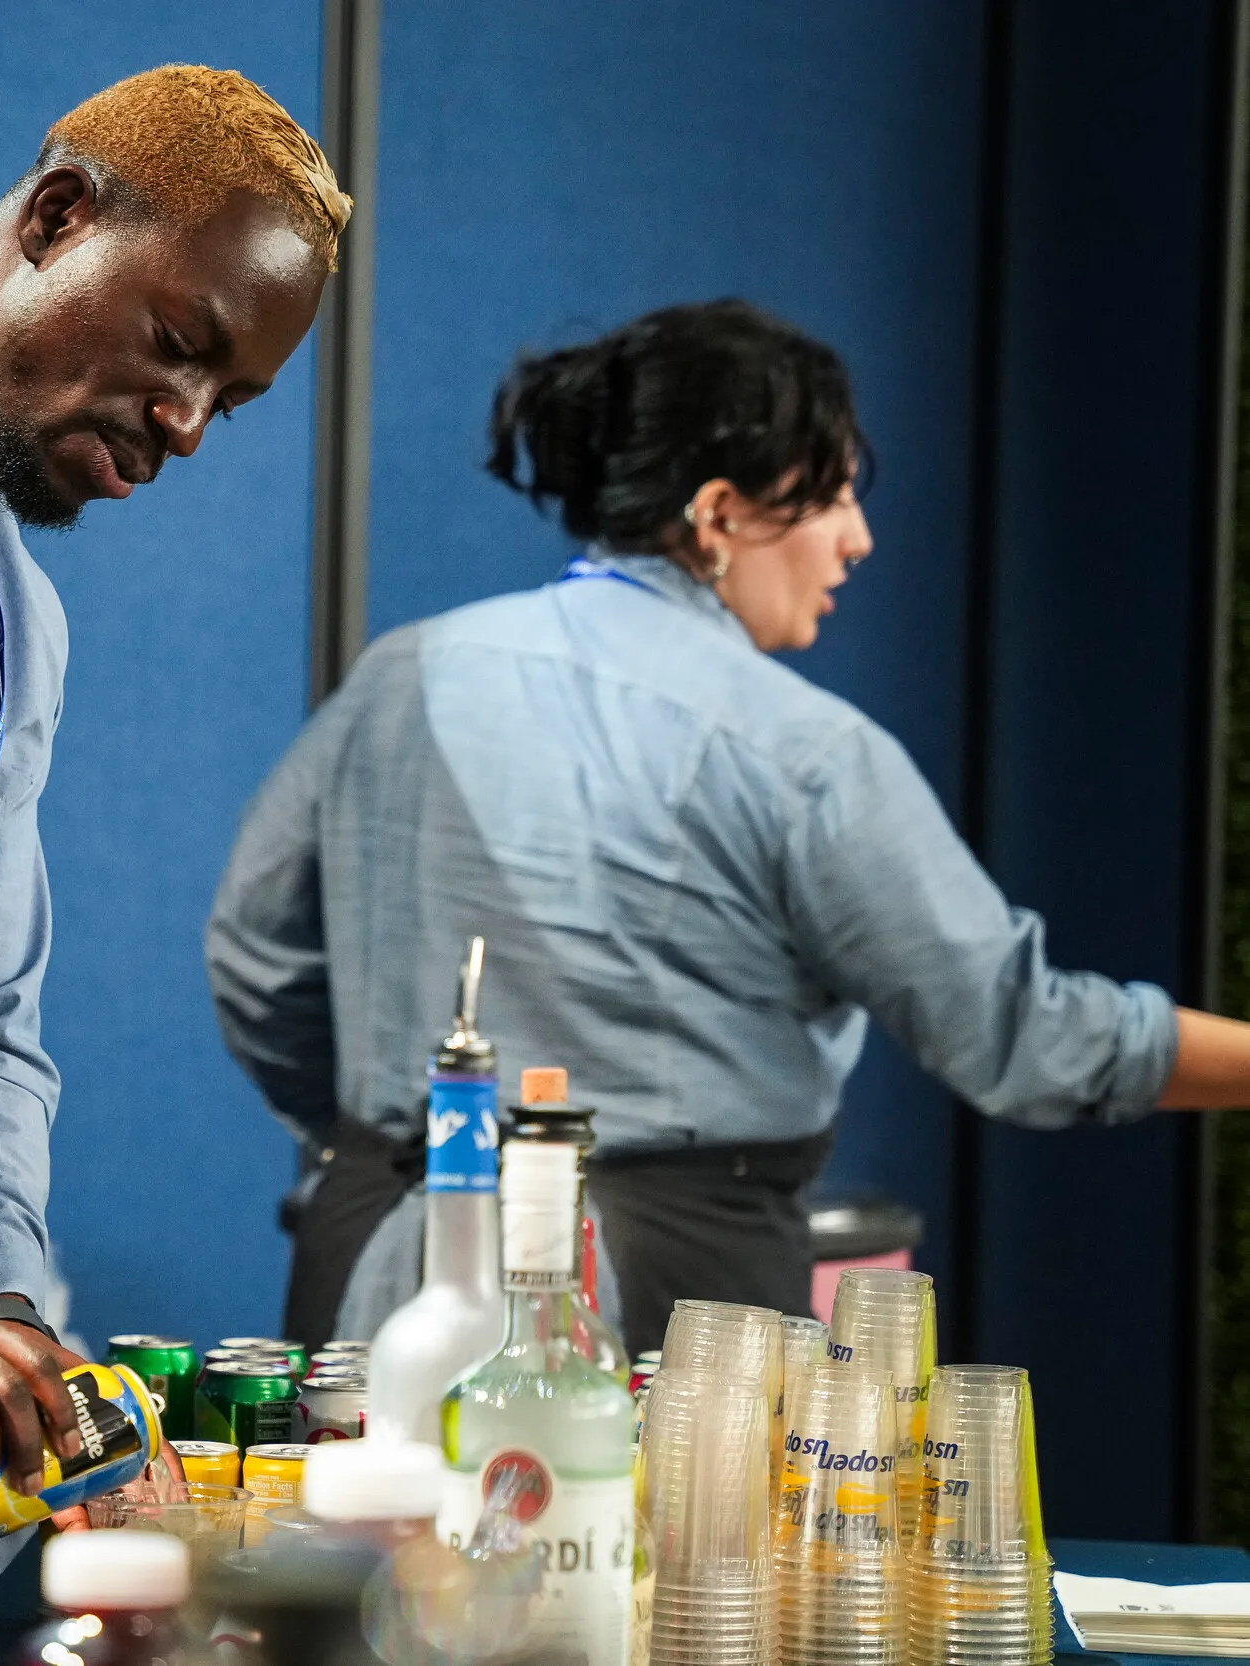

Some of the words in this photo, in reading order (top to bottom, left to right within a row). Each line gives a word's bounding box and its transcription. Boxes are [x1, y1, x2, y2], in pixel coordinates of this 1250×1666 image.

[802, 1438, 829, 1456] us
[934, 1441, 959, 1460] us
[817, 1450, 879, 1472] open
[272, 1481, 294, 1491] Facts
